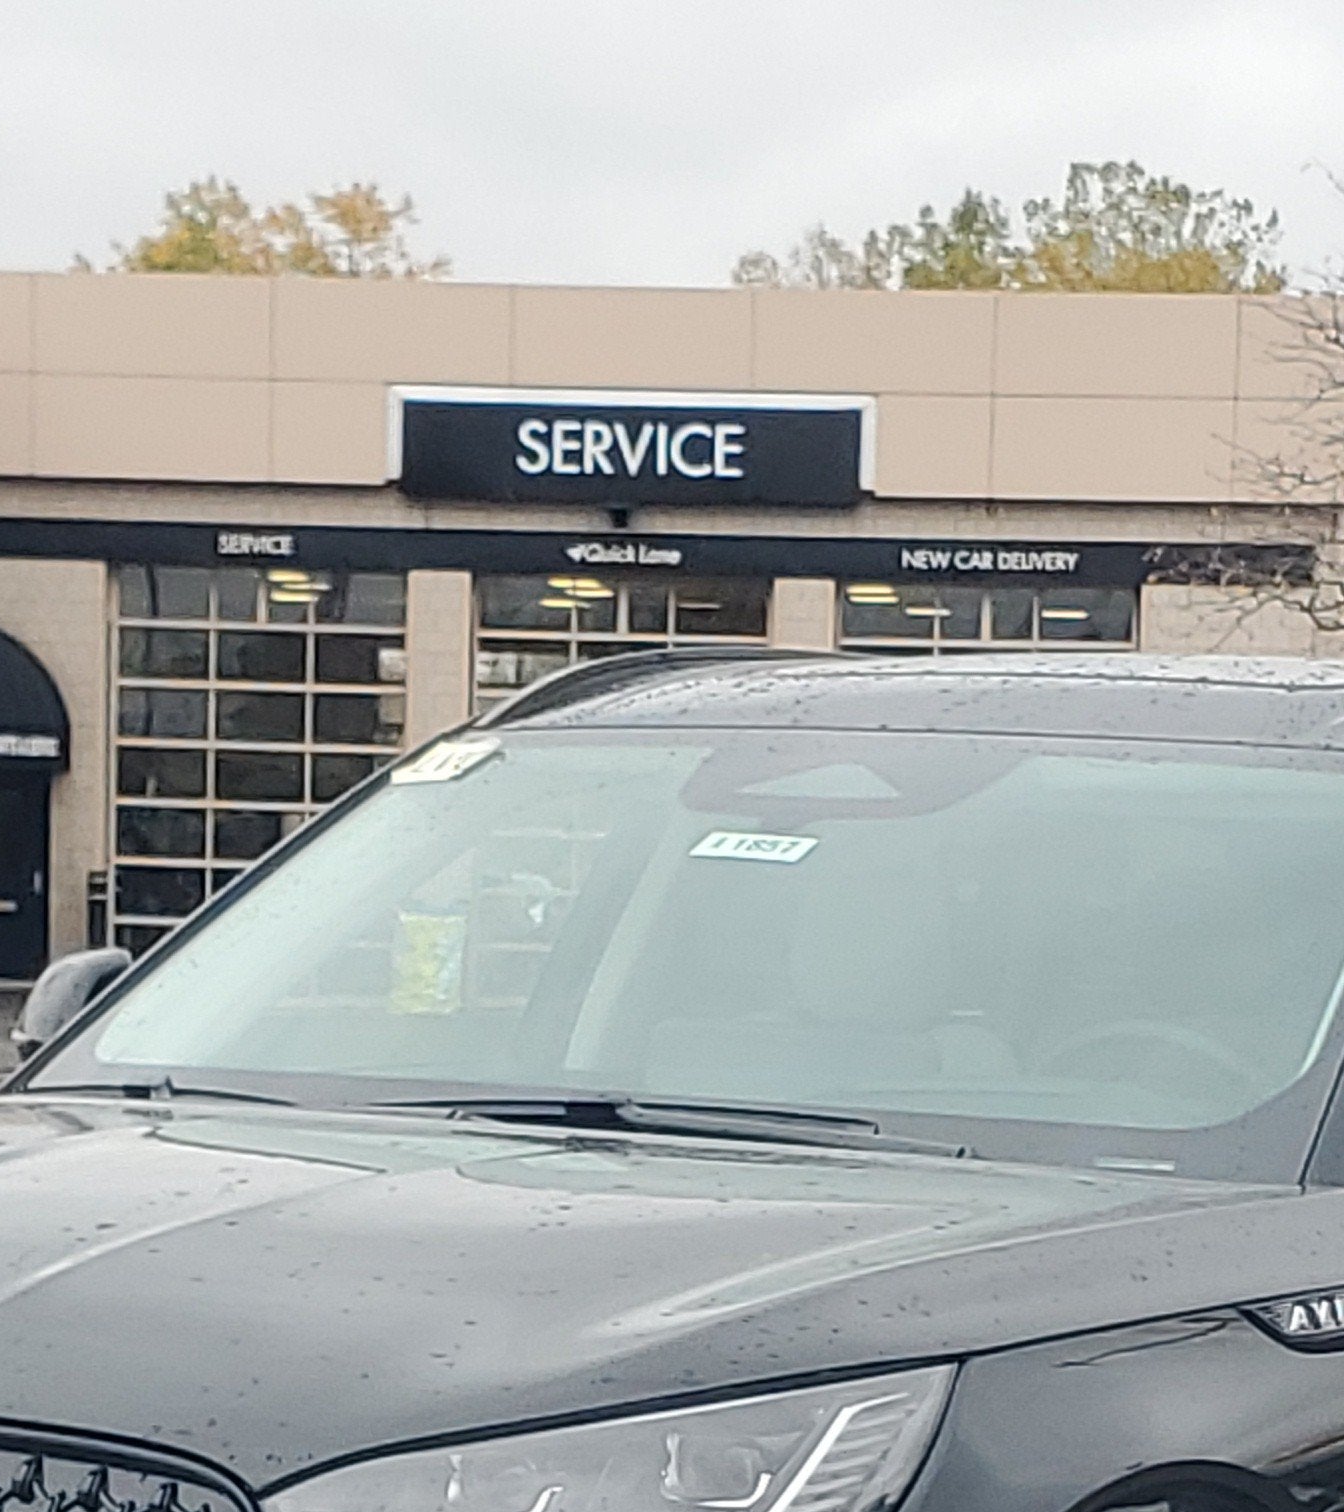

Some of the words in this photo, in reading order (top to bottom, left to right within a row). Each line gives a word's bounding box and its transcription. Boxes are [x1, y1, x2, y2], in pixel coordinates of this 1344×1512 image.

[515, 418, 747, 478] SERVICE
[217, 532, 296, 556] SERVICE
[900, 547, 952, 570] NEW
[954, 550, 994, 571] CAR
[997, 551, 1079, 573] DELIVERY
